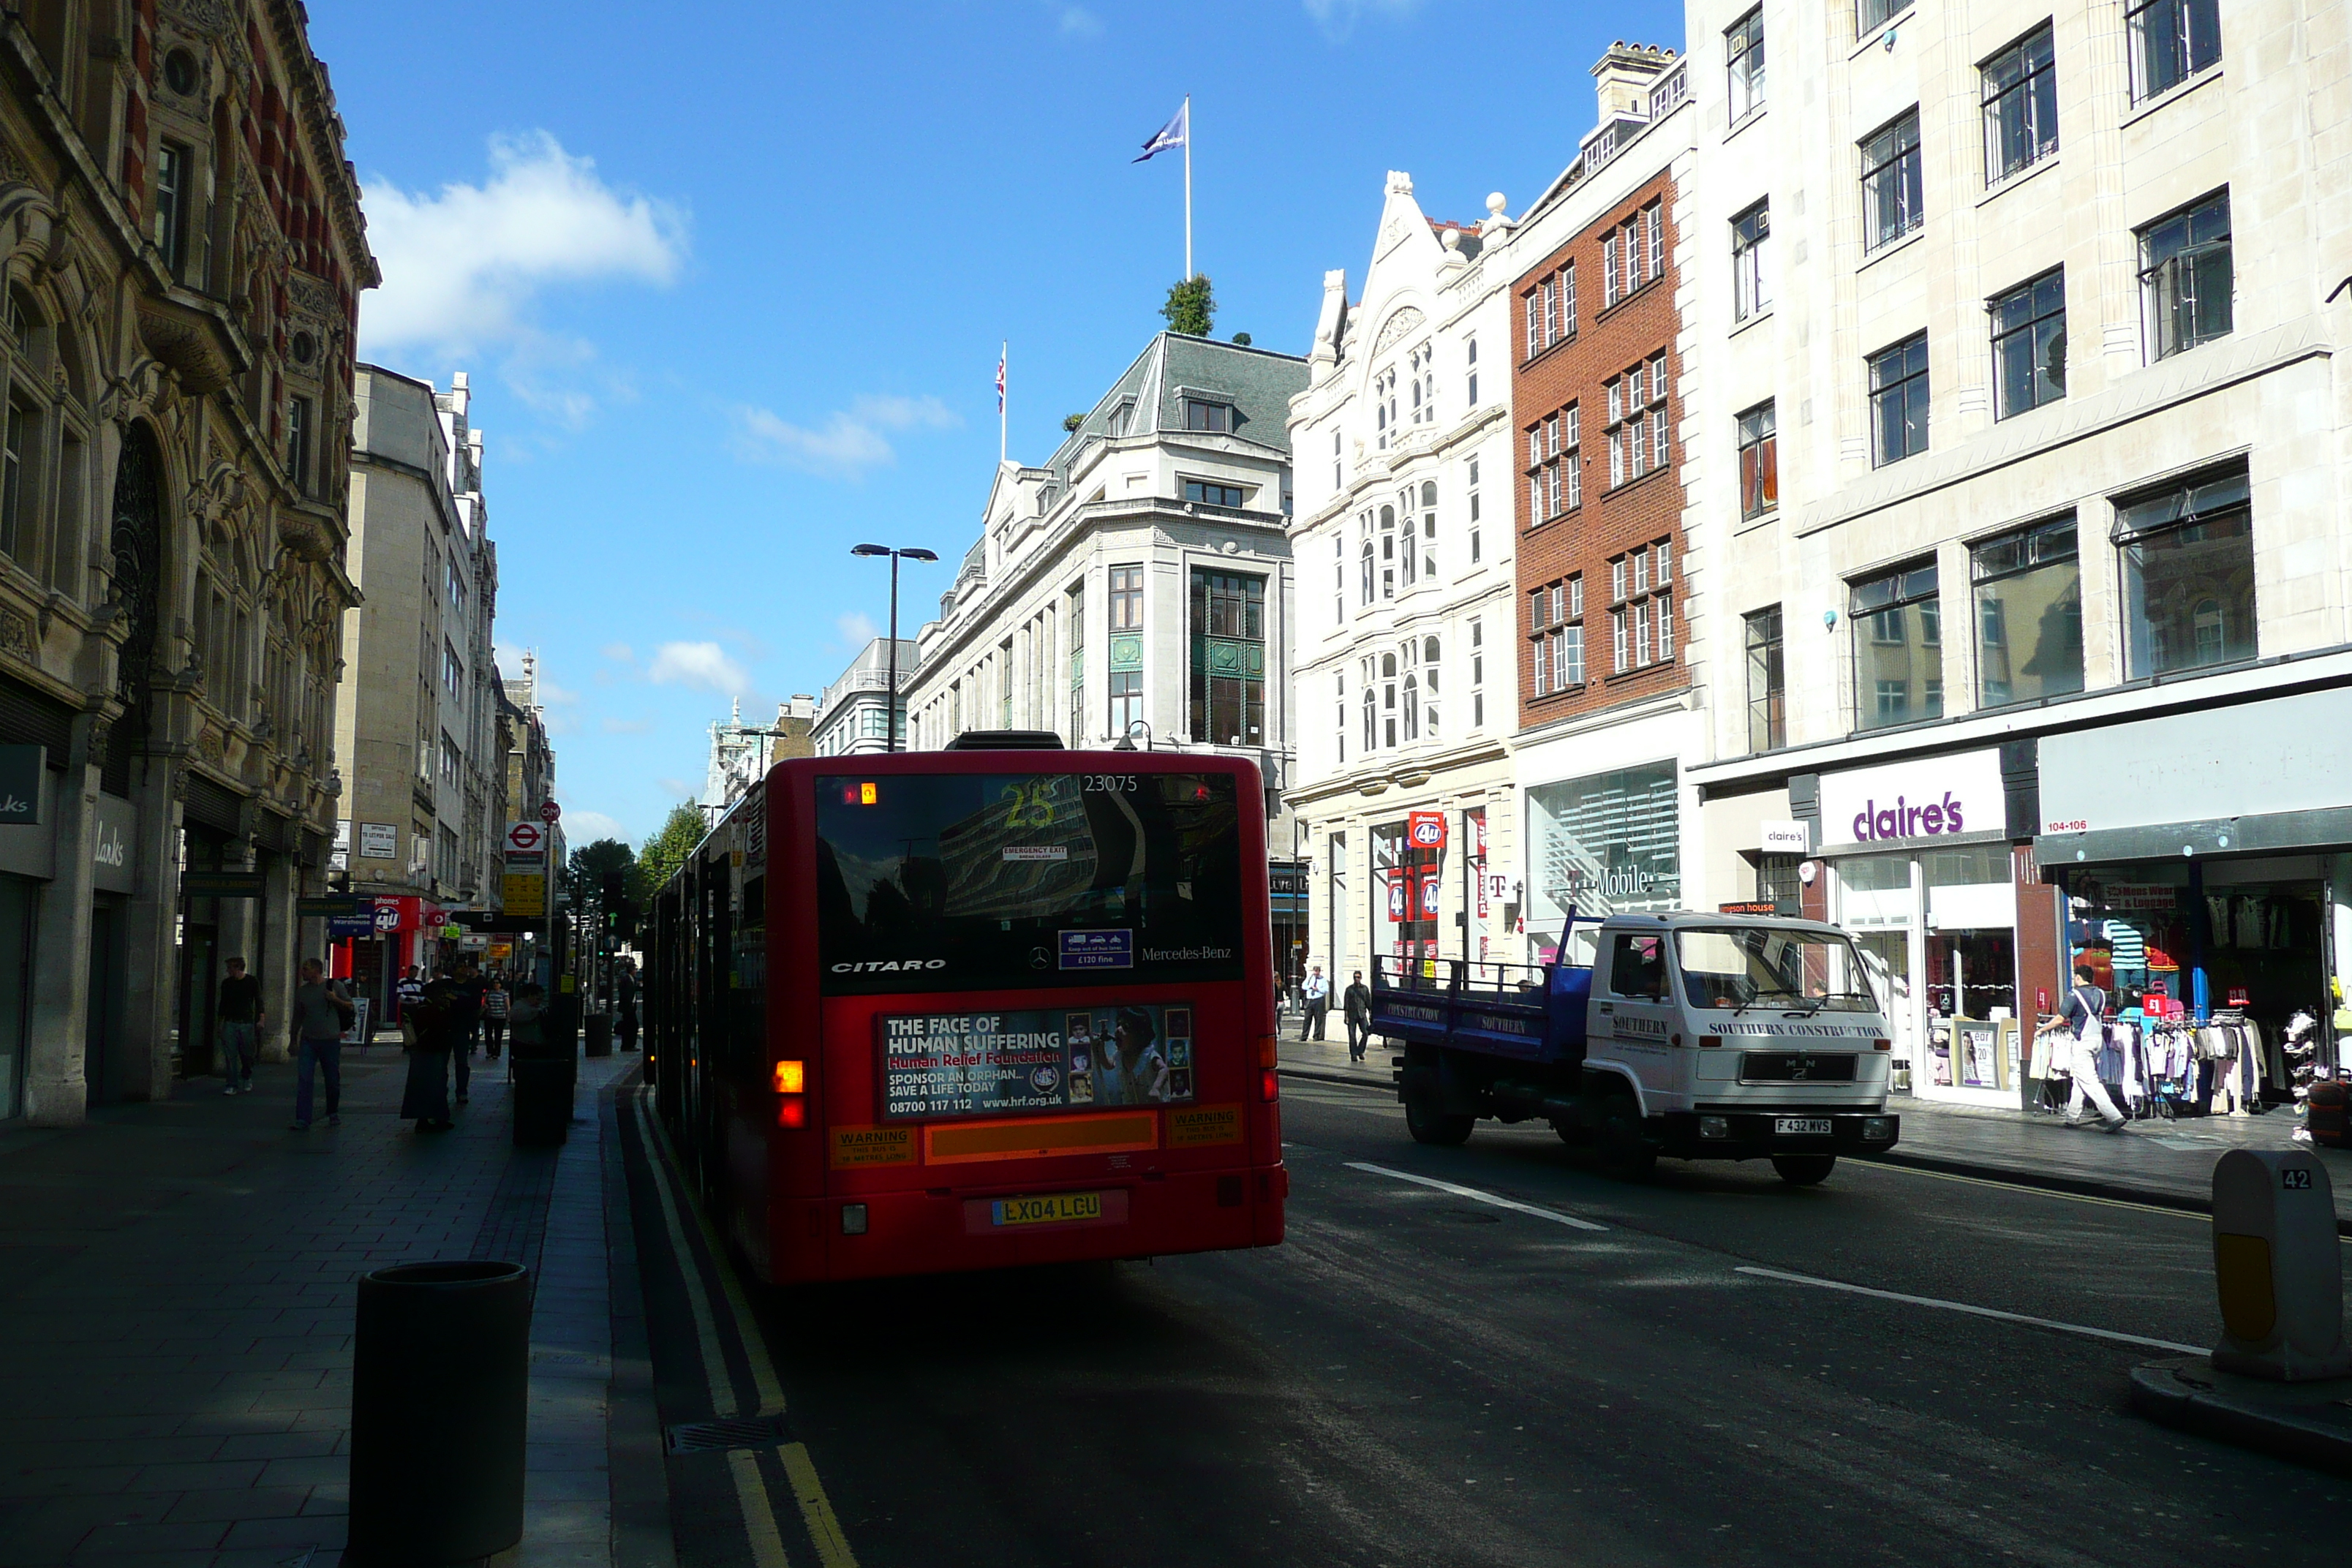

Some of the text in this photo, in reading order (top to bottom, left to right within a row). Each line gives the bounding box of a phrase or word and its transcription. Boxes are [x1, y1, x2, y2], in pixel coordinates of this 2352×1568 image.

[1084, 774, 1138, 792] 23075
[1000, 784, 1055, 827] 25
[1416, 815, 1439, 823] phones
[1852, 791, 1964, 842] claire's
[2048, 820, 2087, 832] 104-106
[95, 820, 124, 867] larks
[1768, 831, 1803, 841] claire's
[1270, 878, 1292, 891] ive
[2149, 886, 2173, 895] Wear
[375, 897, 399, 905] phones
[1746, 902, 1775, 912] house
[2125, 897, 2175, 908] & Luggage
[1077, 954, 1114, 965] £120 fine
[1142, 946, 1232, 962] Mercedes-Benz
[831, 959, 947, 973] CITARO
[1387, 1003, 1439, 1022] CONSTRUCTION
[2148, 998, 2161, 1014] £1
[888, 1016, 1001, 1036] THE FACE OF
[1481, 1015, 1526, 1034] SOUTHERN
[1613, 1015, 1668, 1035] SOUTHERN
[1708, 1022, 1885, 1038] SOUTHERN CONSTRUCTION
[889, 1032, 1060, 1055] HUMAN SUFFERING
[888, 1051, 1061, 1071] Human Relief Foundation
[889, 1073, 945, 1086] SPONSOR
[948, 1071, 964, 1083] AN
[889, 1082, 996, 1097] SAVE A LIFE TODAY
[889, 1098, 973, 1113] 08700 117 112
[982, 1094, 1063, 1109] www.hrf.org.uk
[1175, 1111, 1235, 1124] WARNING
[1778, 1120, 1830, 1132] F 432 MVS
[840, 1131, 908, 1144] WARNING
[2285, 1170, 2310, 1188] 42
[1004, 1196, 1098, 1221] LX04 LCU
